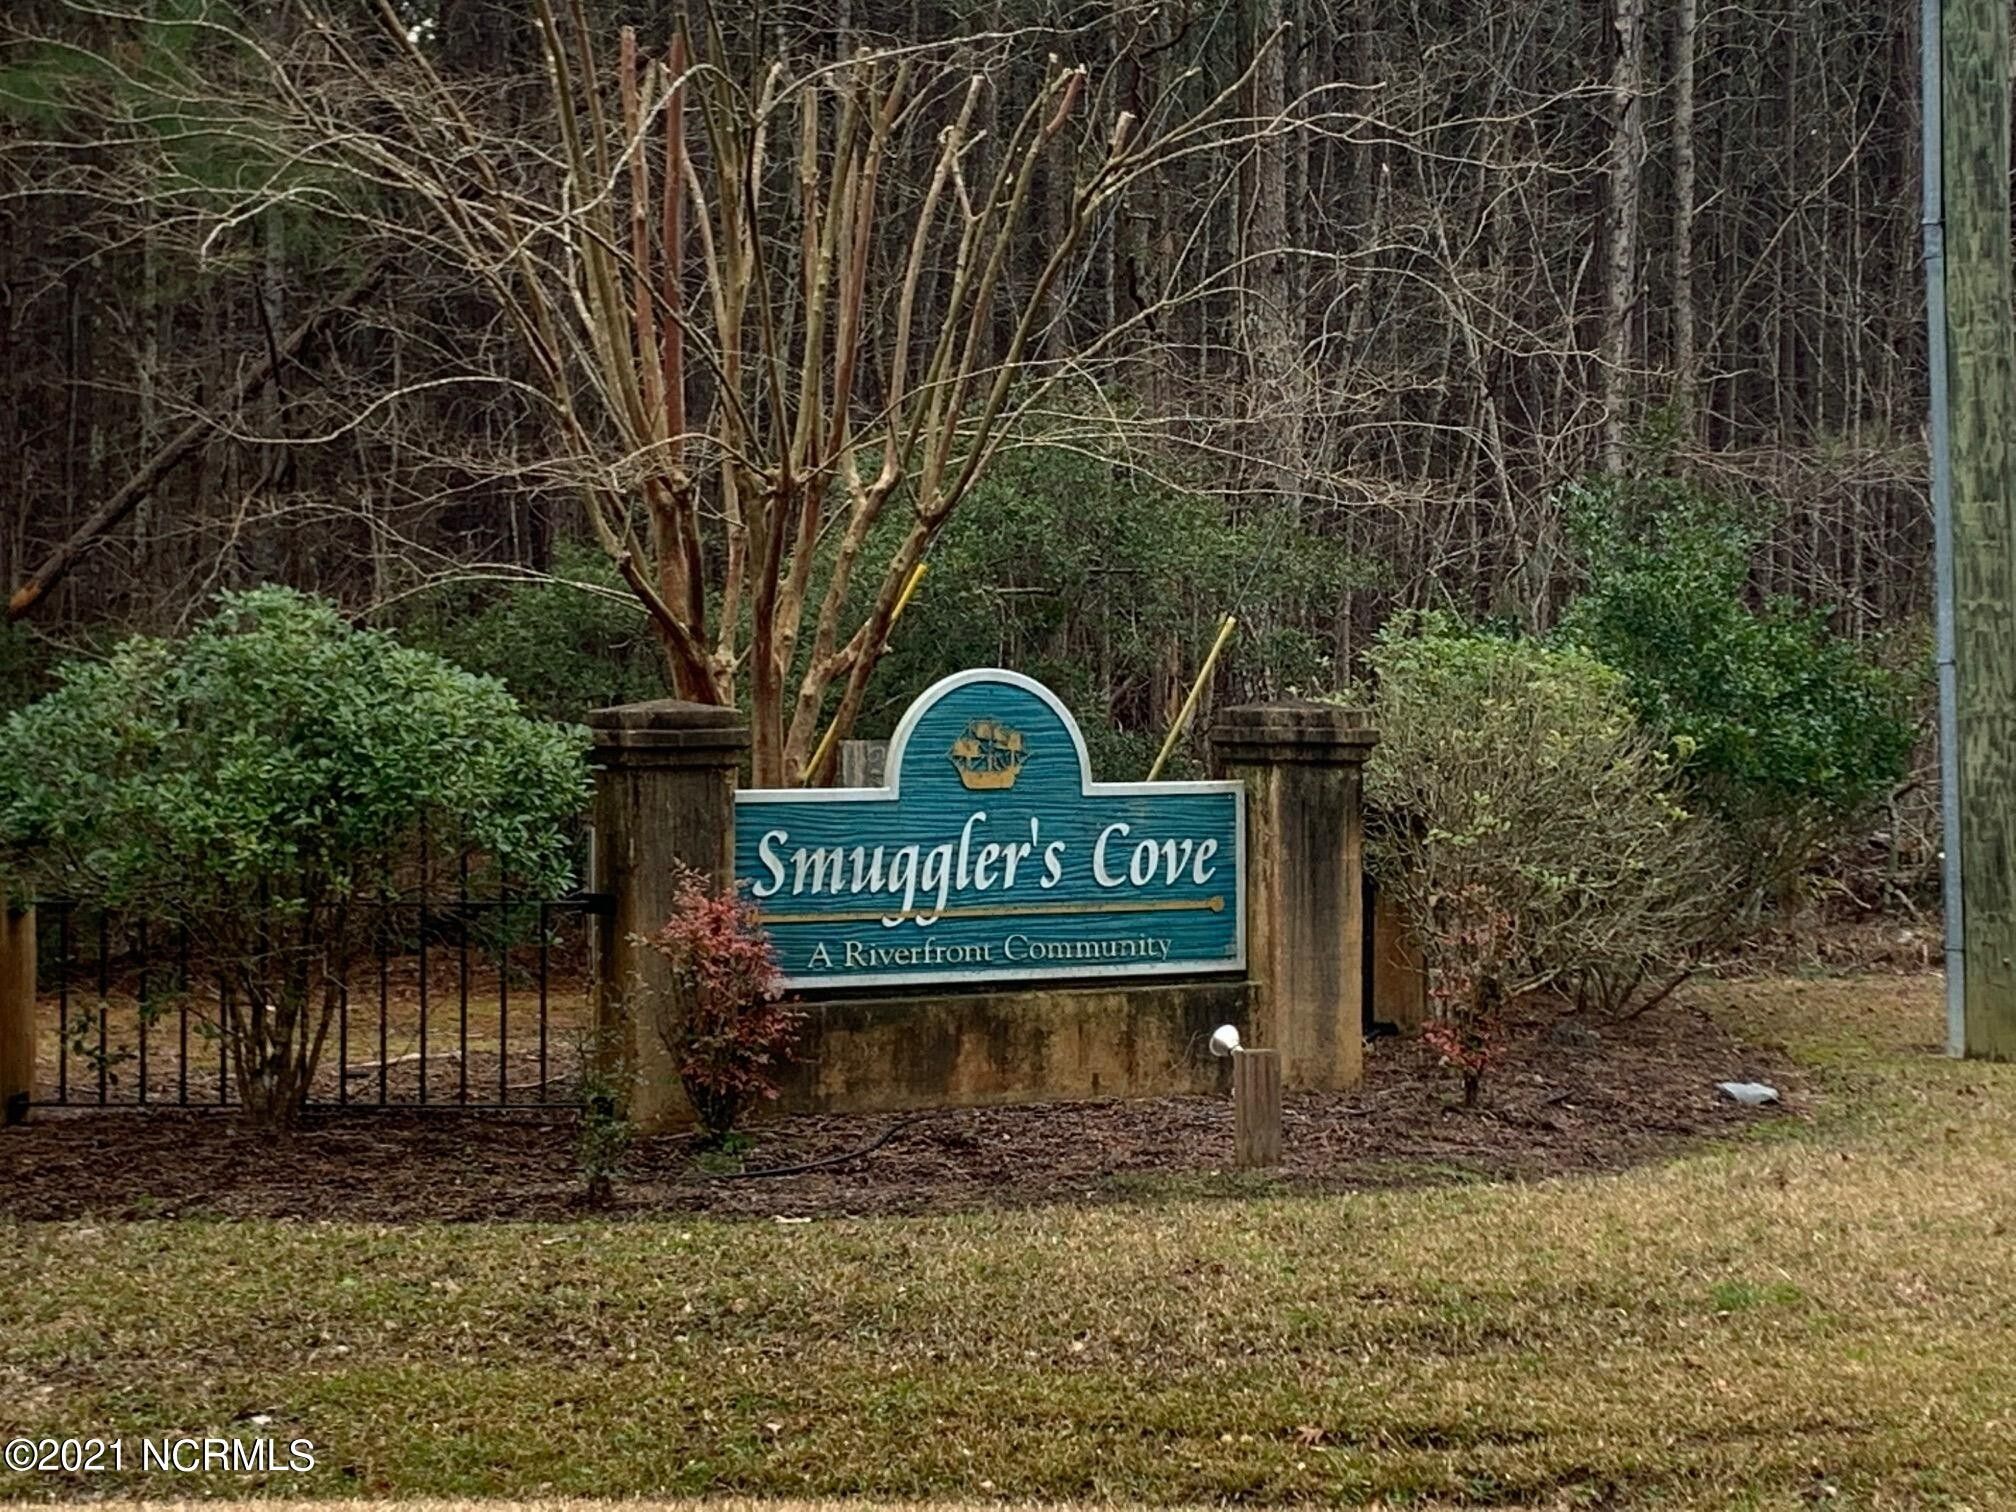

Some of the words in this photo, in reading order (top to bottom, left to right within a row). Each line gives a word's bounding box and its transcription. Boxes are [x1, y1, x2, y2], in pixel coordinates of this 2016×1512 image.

[752, 811, 1065, 927] Smuggler's
[1093, 822, 1218, 888] Cove
[807, 942, 833, 968] A
[843, 937, 992, 968] Riverfront
[1004, 933, 1172, 962] Community
